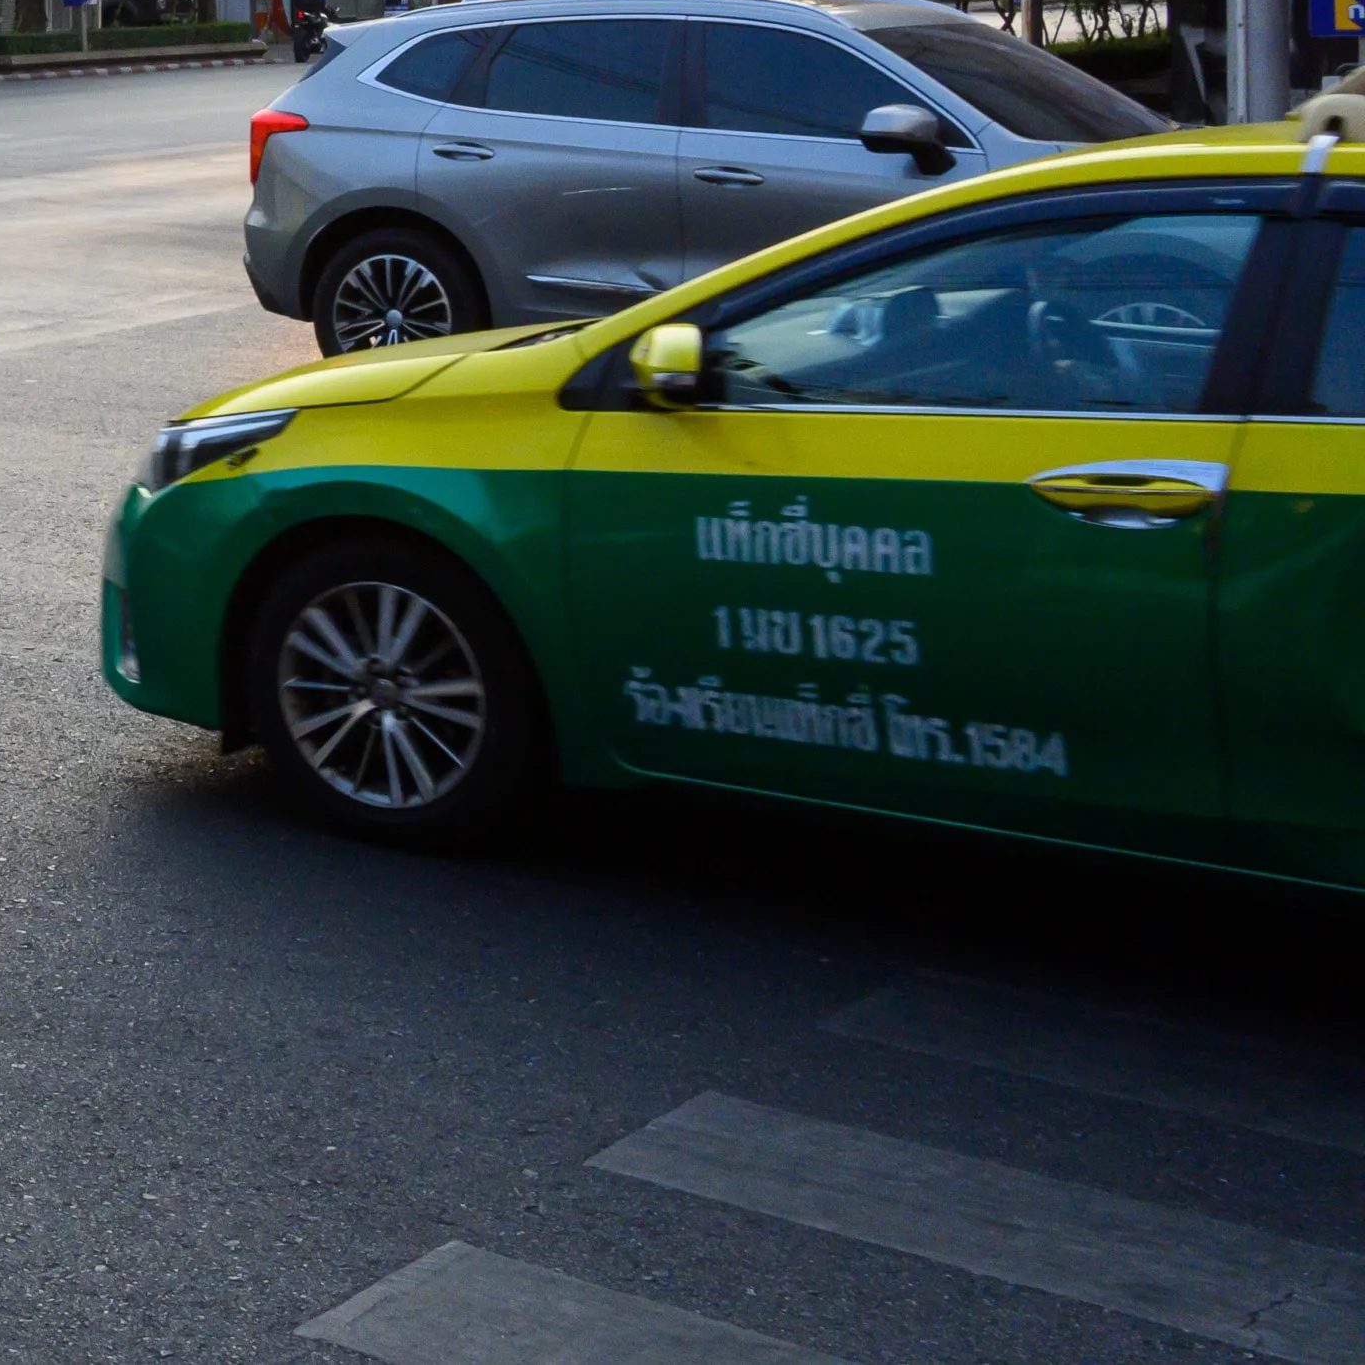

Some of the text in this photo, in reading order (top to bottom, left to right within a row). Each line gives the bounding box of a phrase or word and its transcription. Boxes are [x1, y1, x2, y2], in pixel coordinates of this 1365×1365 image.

[695, 494, 933, 584] แท็กซี่บุคคล
[808, 614, 921, 666] 1625
[623, 665, 878, 753] ร้องเรียนแท็กซี่
